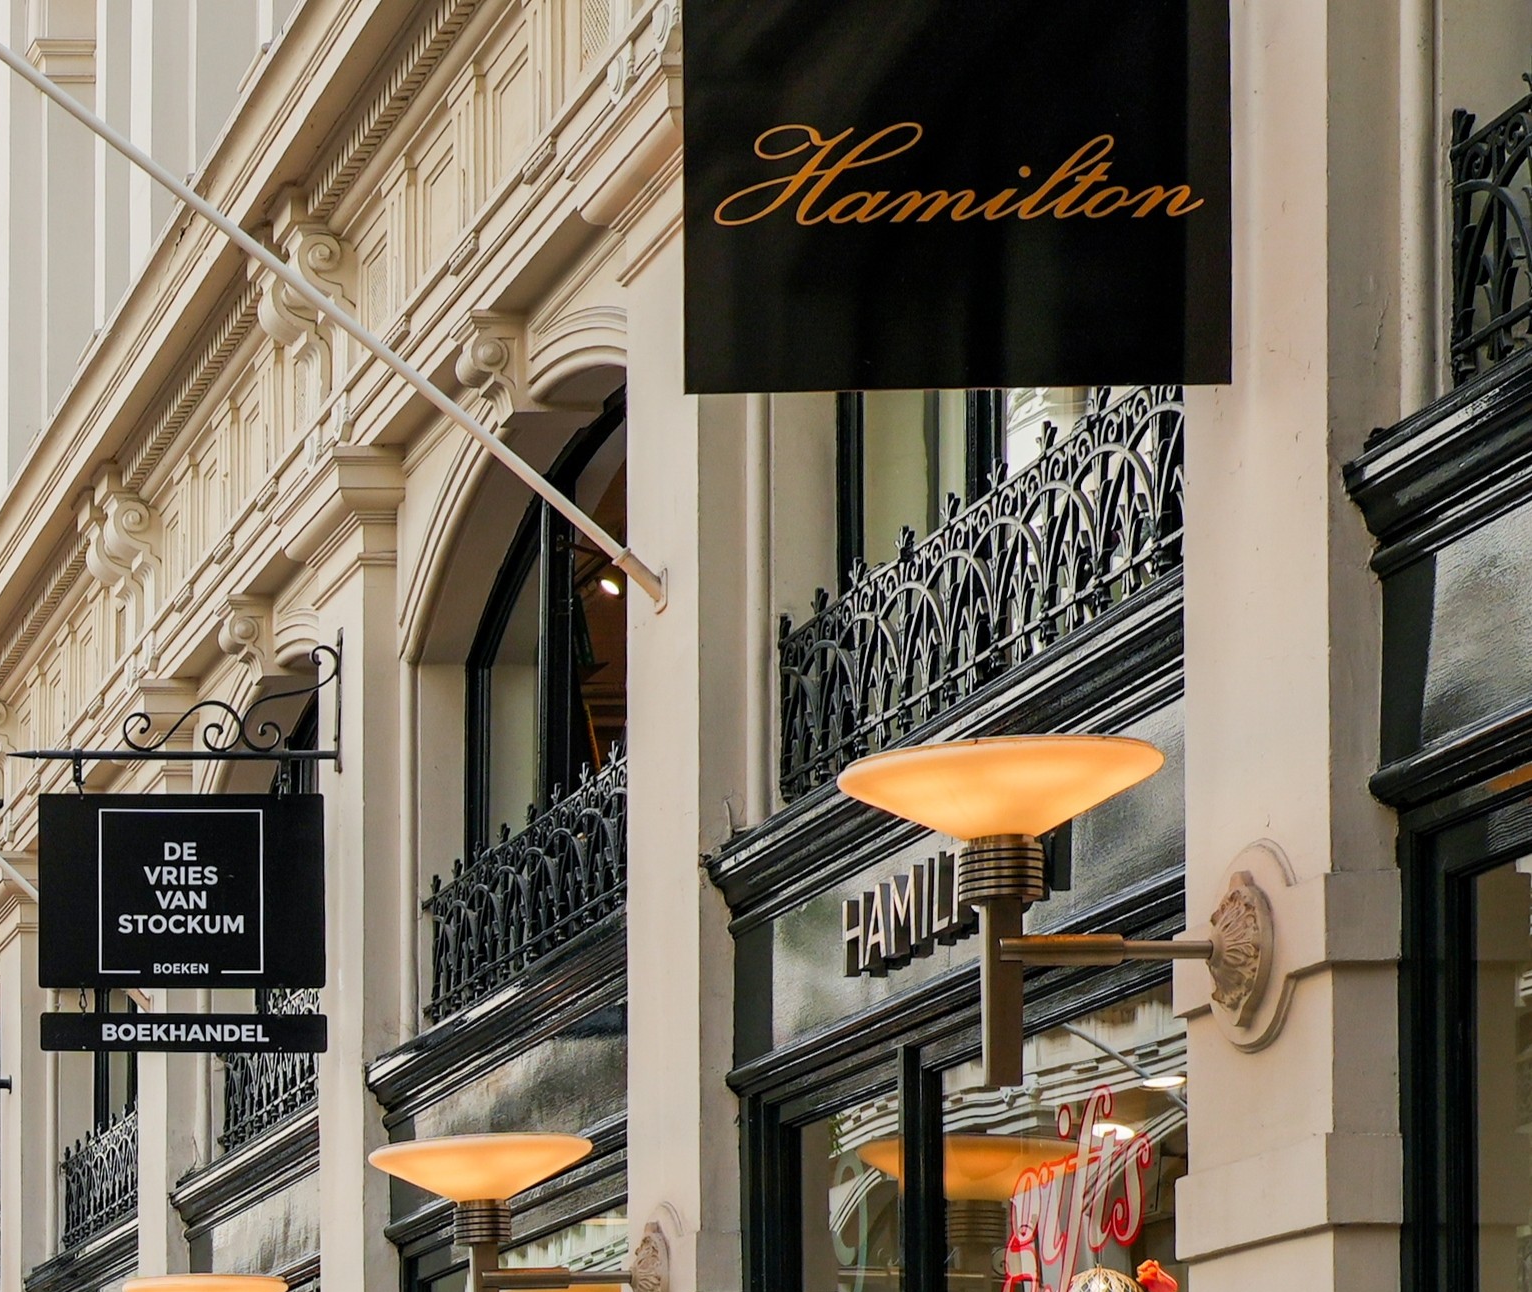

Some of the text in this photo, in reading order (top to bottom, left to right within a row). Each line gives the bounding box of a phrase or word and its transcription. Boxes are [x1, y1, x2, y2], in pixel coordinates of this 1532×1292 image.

[714, 122, 1205, 225] Hamilton
[164, 842, 197, 861] DE
[143, 866, 218, 885] VRIES
[155, 890, 207, 909] VAN
[842, 848, 959, 976] HAMILT
[117, 914, 244, 935] STOCKUM
[153, 963, 209, 974] BOEKEN
[102, 1023, 270, 1042] BOEKHANDEL
